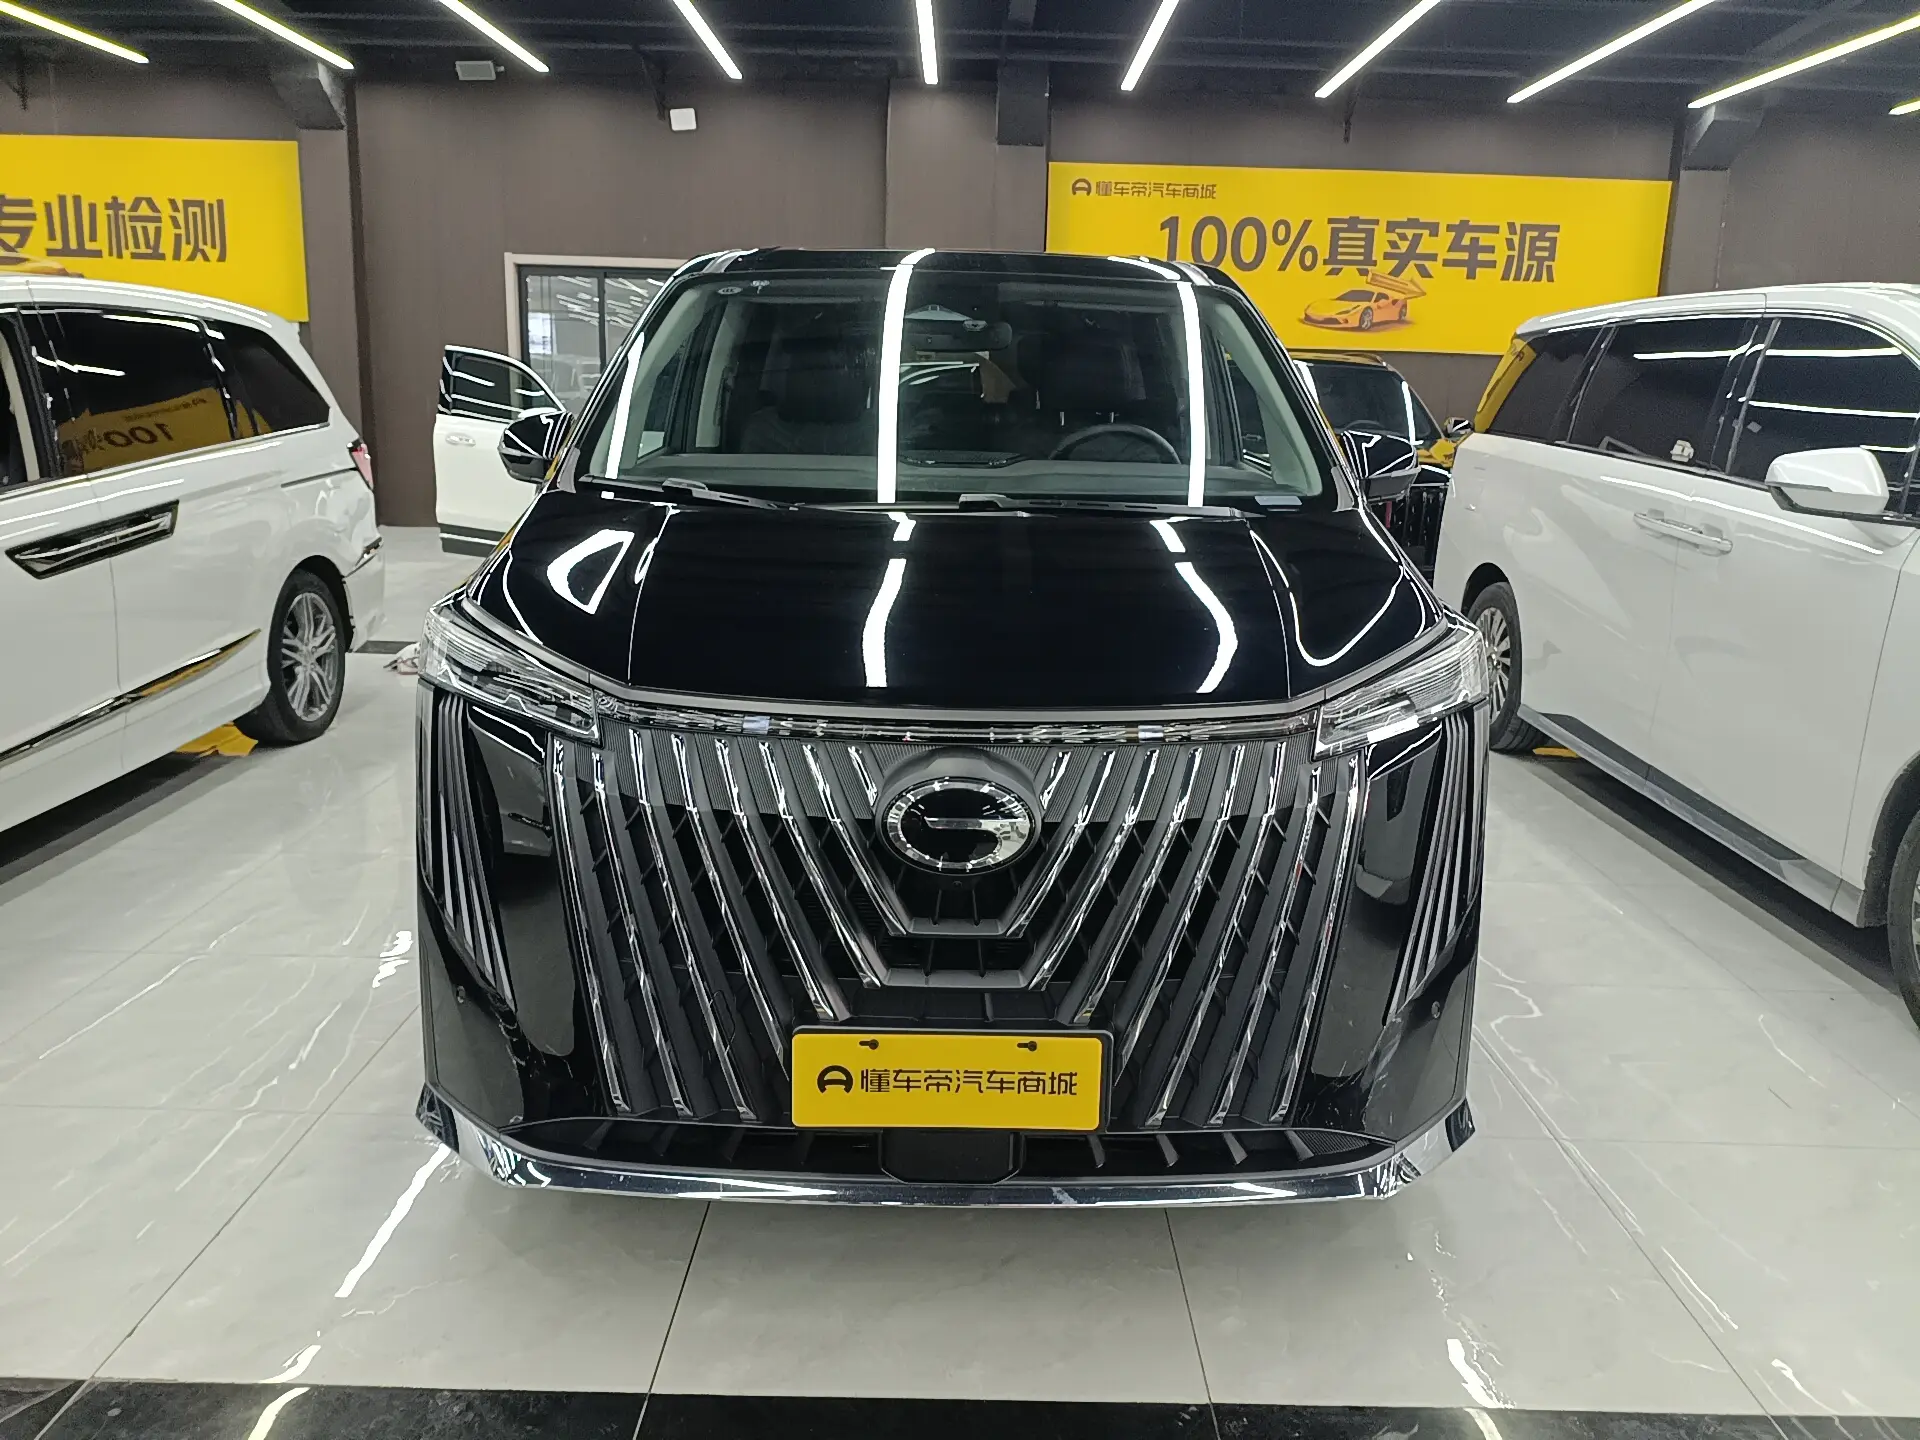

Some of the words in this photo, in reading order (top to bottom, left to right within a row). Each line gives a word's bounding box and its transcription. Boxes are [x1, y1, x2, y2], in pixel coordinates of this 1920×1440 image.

[1096, 181, 1218, 199] 懂车帝汽车商城
[0, 194, 227, 262] 专业检测
[1159, 215, 1561, 283] 100%真实车源
[860, 1068, 1078, 1096] 懂车帝汽车商城
